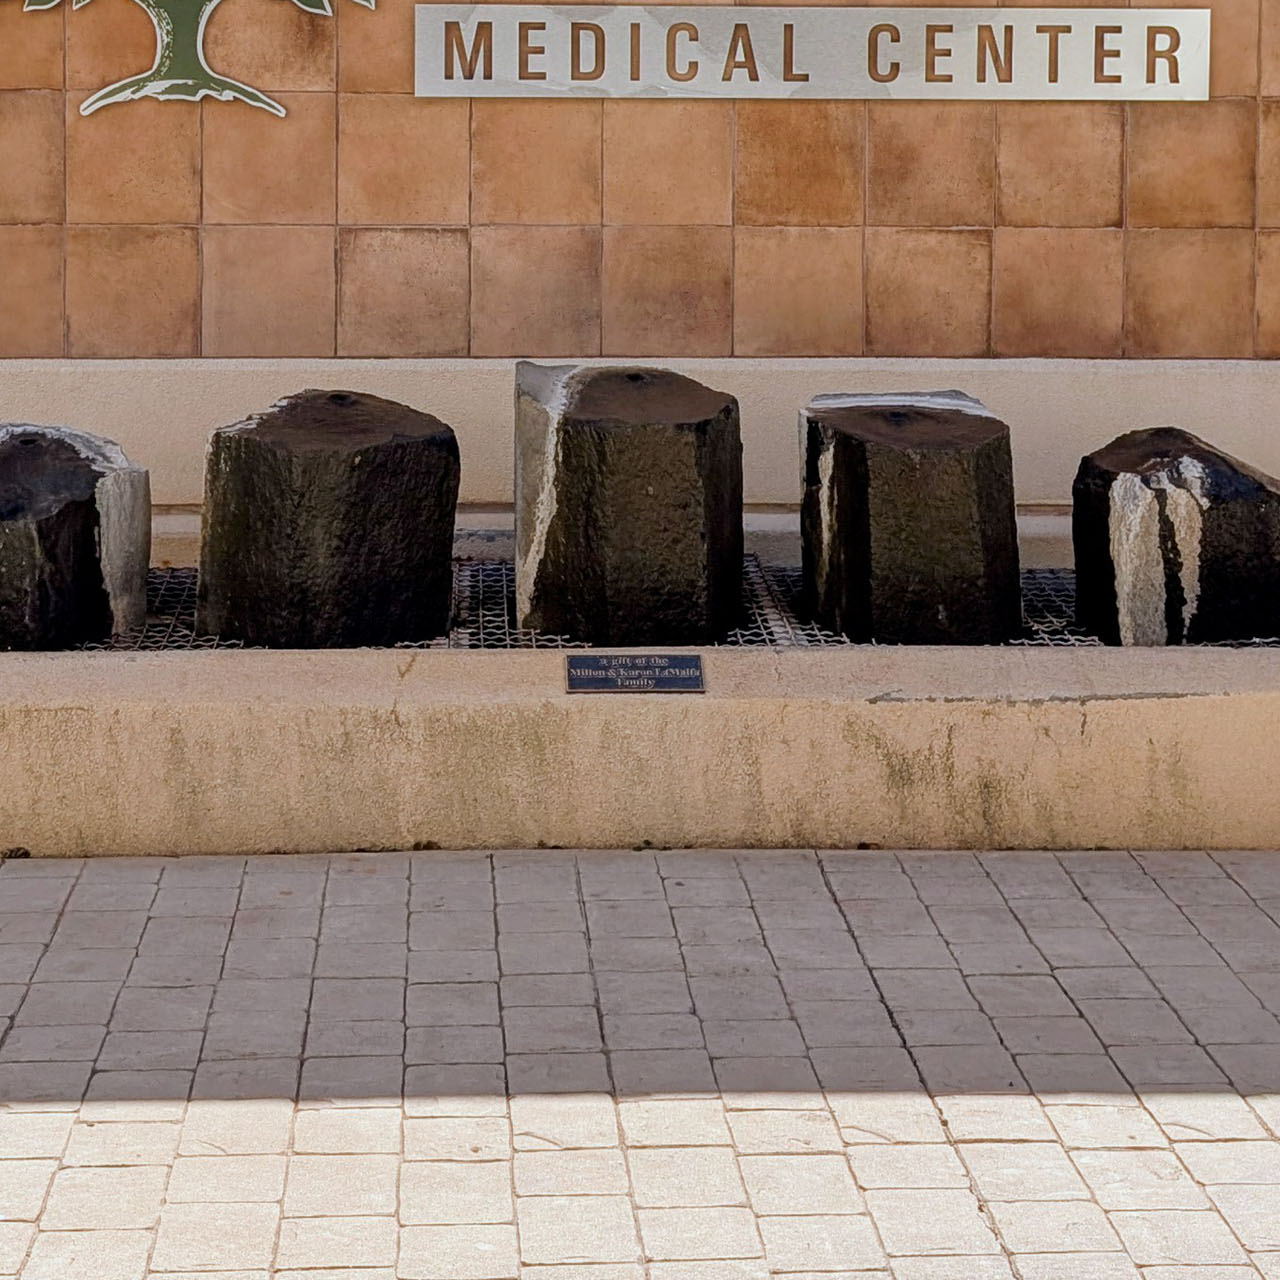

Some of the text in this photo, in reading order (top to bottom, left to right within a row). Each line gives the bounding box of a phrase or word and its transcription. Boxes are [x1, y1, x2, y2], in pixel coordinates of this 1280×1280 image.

[443, 20, 1183, 85] MEDICAL CENTER
[611, 657, 632, 668] gift
[635, 657, 647, 666] of
[649, 656, 669, 666] the
[570, 668, 605, 677] Milton
[607, 669, 617, 678] &
[617, 678, 655, 689] Family
